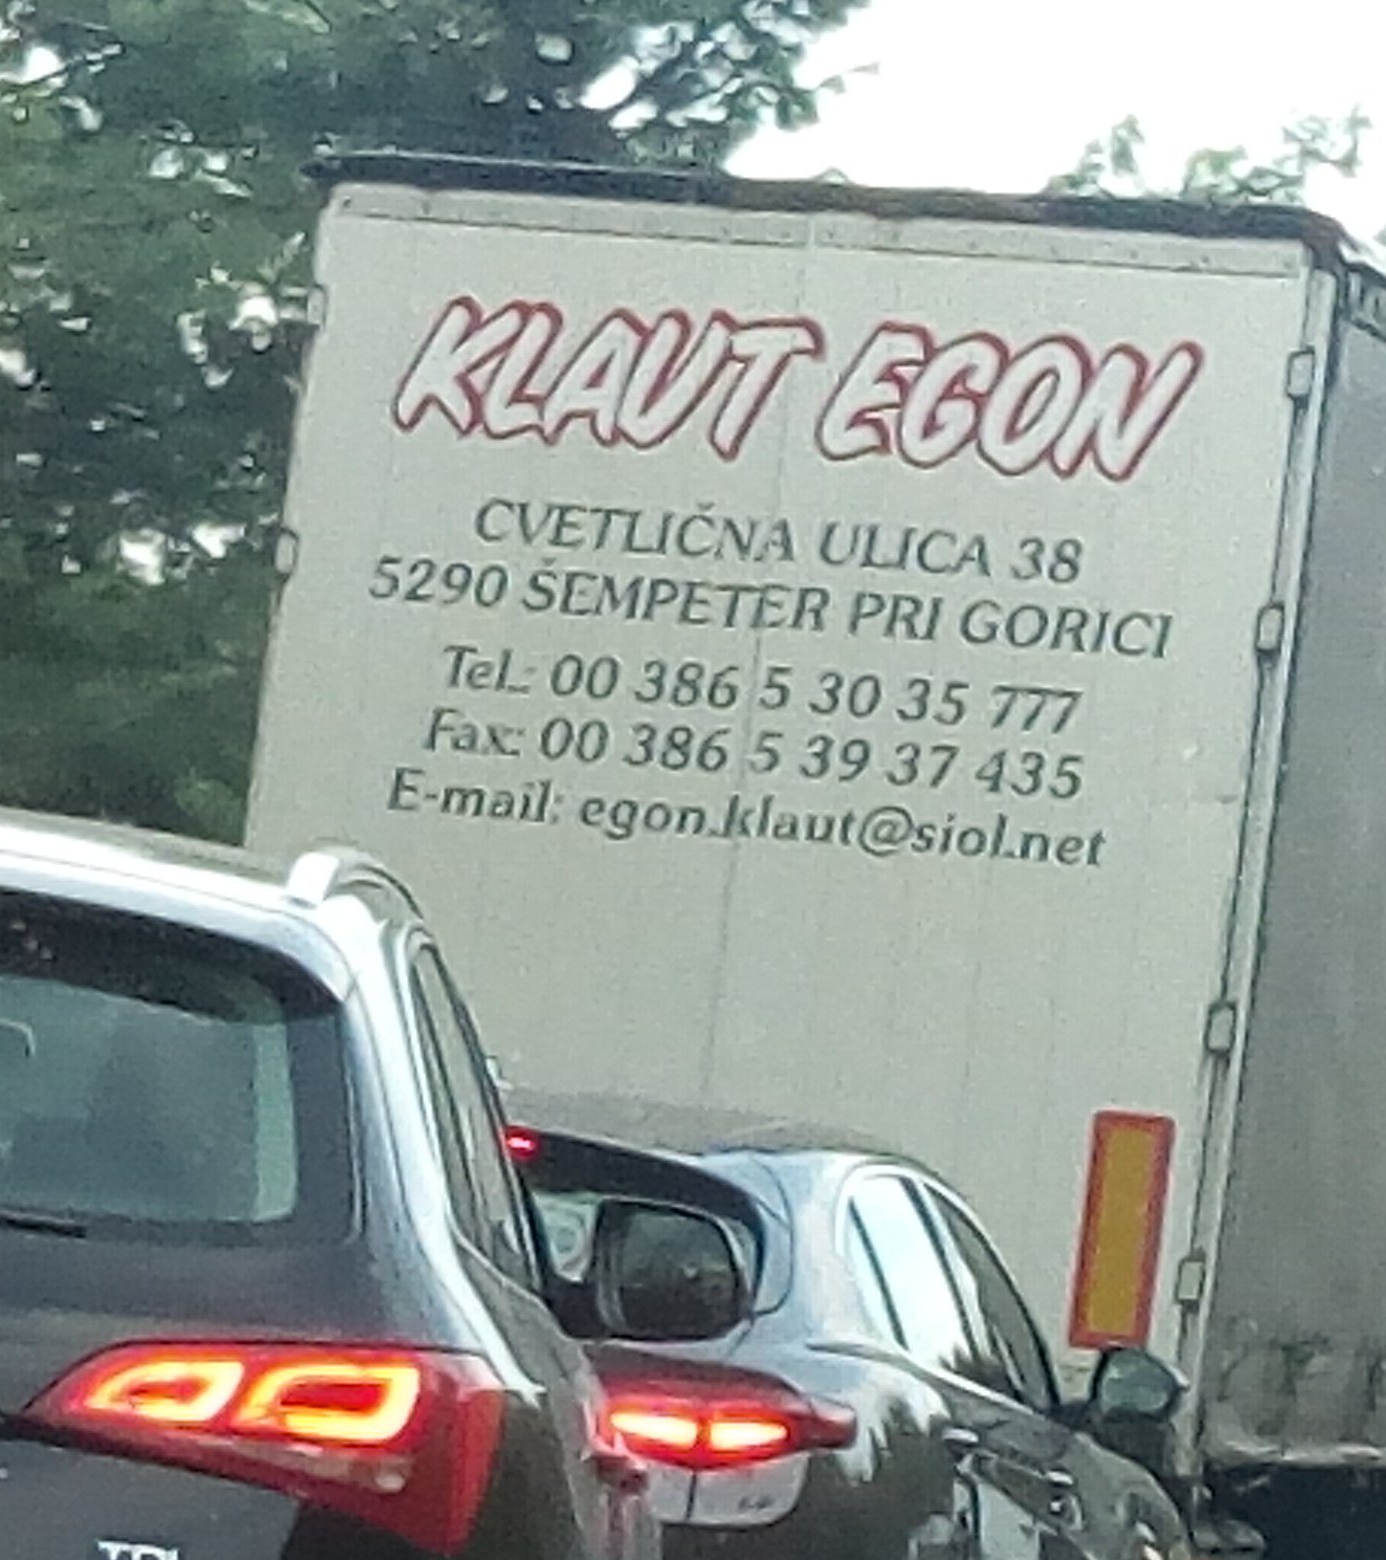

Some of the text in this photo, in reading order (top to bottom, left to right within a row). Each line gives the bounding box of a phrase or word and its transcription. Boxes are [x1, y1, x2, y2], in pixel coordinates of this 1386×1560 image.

[392, 296, 1204, 482] KLAUT EGON
[475, 498, 1083, 584] CVETLIČNA ULICA 38
[369, 555, 1172, 659] 5290 ŠEMPETER PRI GORICI
[550, 653, 620, 700] 00
[635, 659, 739, 710] 386
[759, 665, 793, 711] 5
[809, 671, 881, 719] 30
[895, 677, 970, 726] 35
[991, 684, 1084, 734] 777
[423, 706, 1084, 799] Fax: 00 386 5 39 37 435
[387, 767, 1107, 868] E-mail: egon.klaut@siol.net
